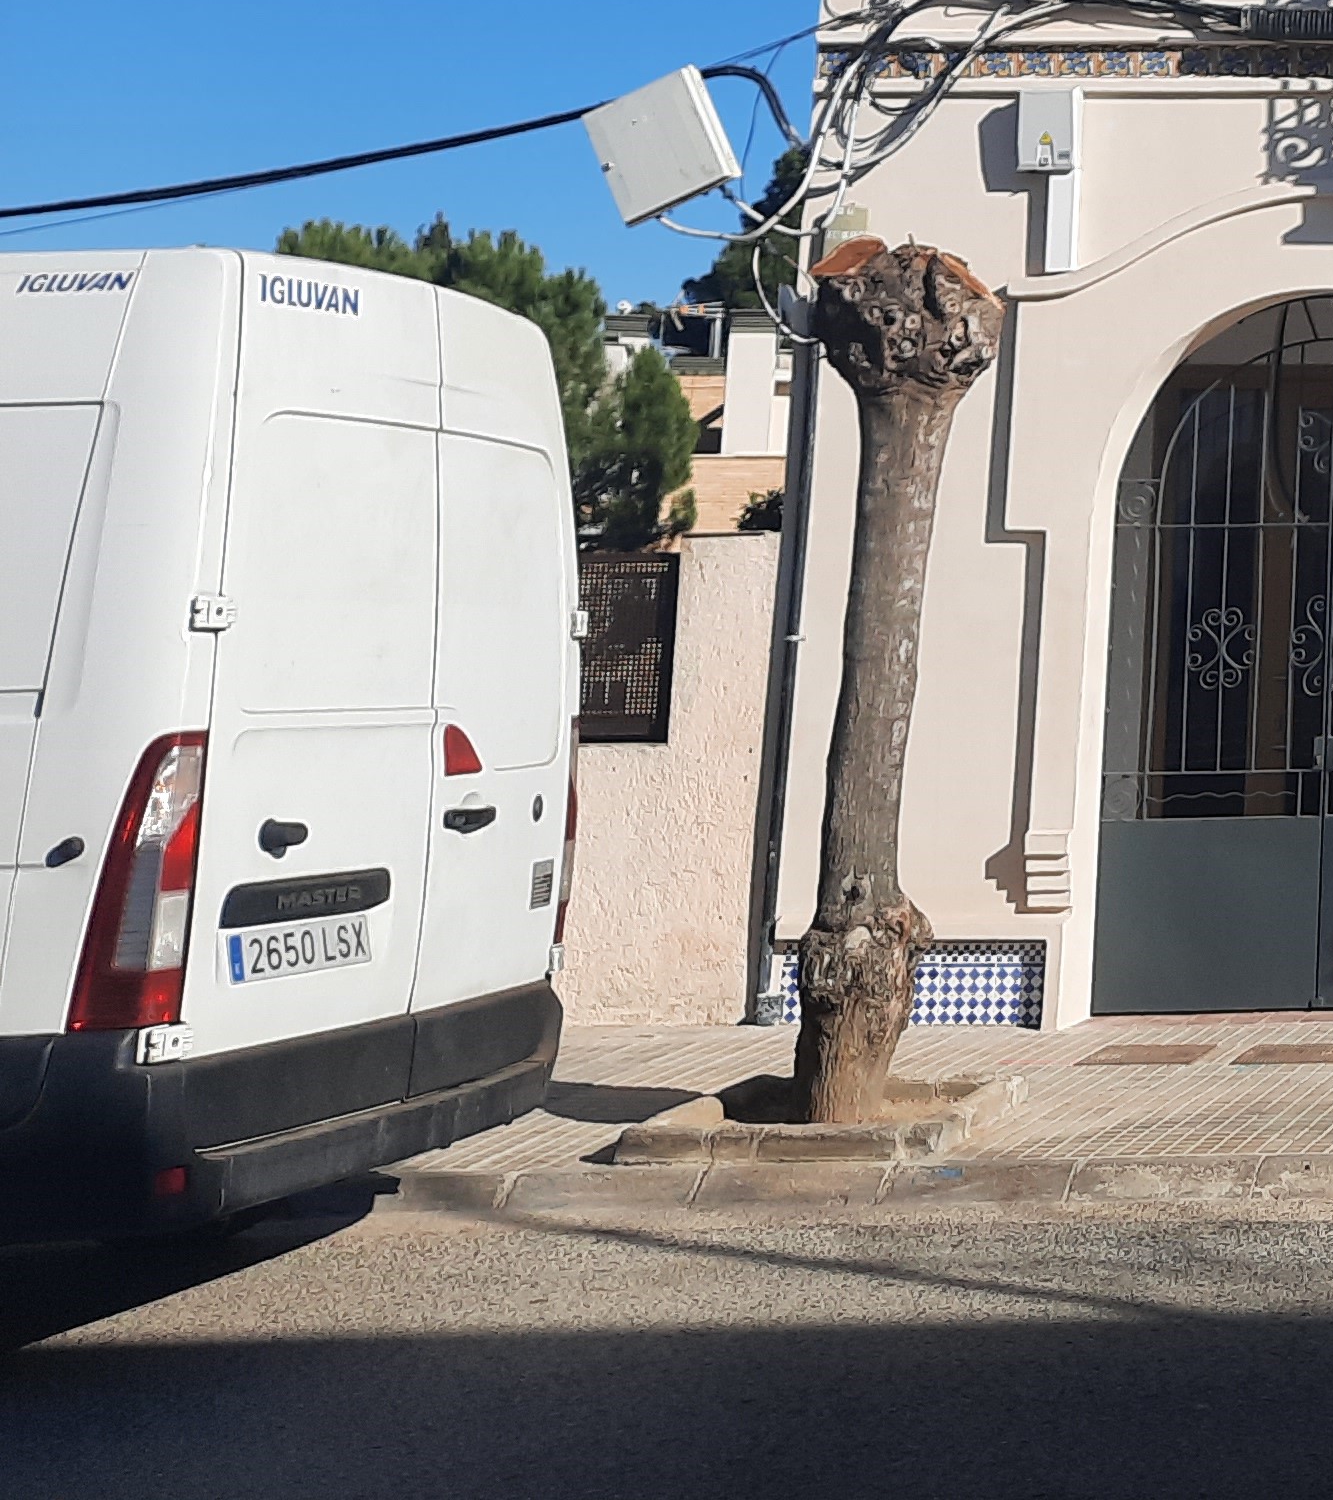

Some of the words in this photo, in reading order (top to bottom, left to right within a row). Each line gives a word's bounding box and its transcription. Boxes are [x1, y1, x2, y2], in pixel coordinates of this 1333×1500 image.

[16, 271, 135, 294] IGLUVAN
[258, 273, 360, 317] IGLUVAN
[277, 886, 361, 910] MASTER
[248, 929, 315, 974] 2650
[321, 920, 367, 962] LSX
